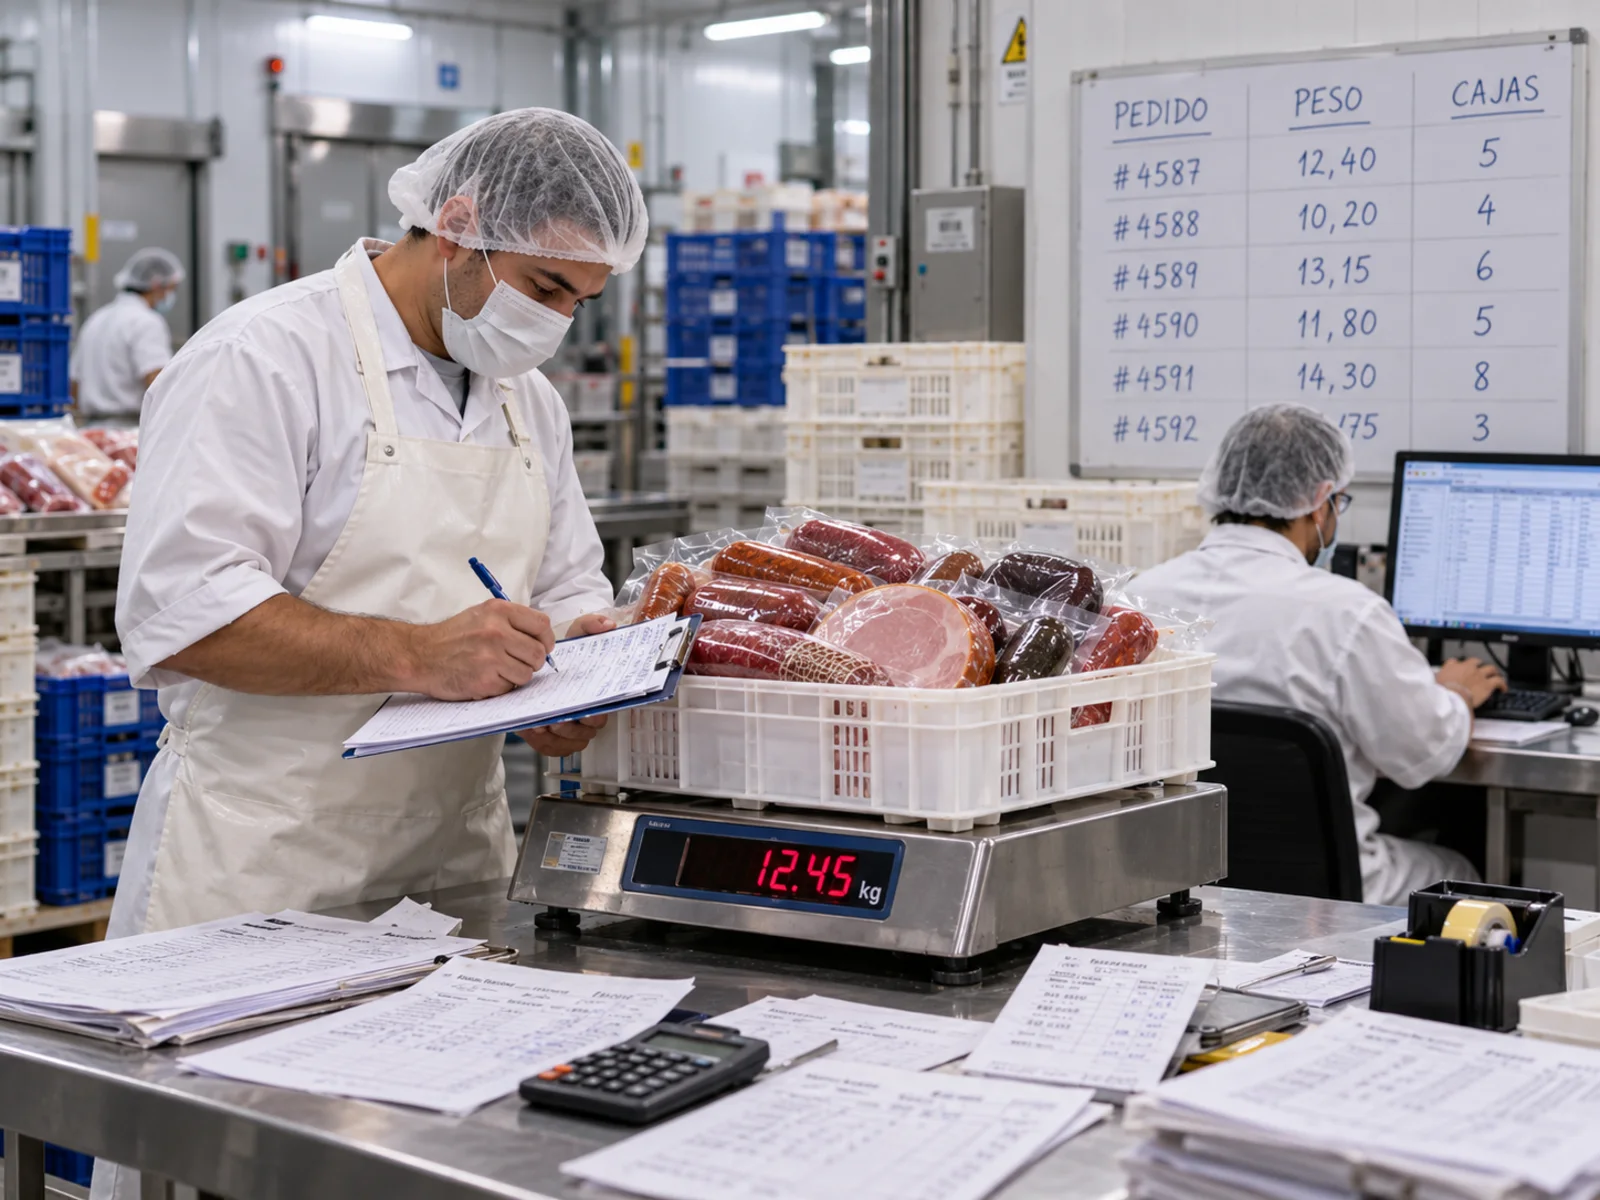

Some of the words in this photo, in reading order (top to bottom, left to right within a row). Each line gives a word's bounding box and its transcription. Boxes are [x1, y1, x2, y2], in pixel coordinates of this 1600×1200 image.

[1295, 85, 1363, 117] PESO
[1452, 75, 1540, 107] CAJAS
[1115, 97, 1209, 130] PEDIDO
[1299, 147, 1376, 179] 12,40
[1479, 137, 1500, 168] 5
[1113, 158, 1201, 190] #4587
[1113, 210, 1200, 241] #4588
[1299, 201, 1377, 234] 10,20
[1478, 195, 1495, 225] 4
[1113, 261, 1198, 291] #4589
[1298, 255, 1371, 288] 13,15
[1476, 250, 1493, 280] 6
[1113, 312, 1199, 339] #4590
[1298, 308, 1377, 342] 11,80
[1474, 306, 1495, 336] 5
[1113, 364, 1194, 392] #4591
[1298, 363, 1377, 394] 14,30
[1474, 361, 1490, 391] 8
[1113, 414, 1198, 442] #4592
[1473, 414, 1490, 442] 3
[757, 849, 856, 897] 12.45
[858, 880, 882, 905] kg
